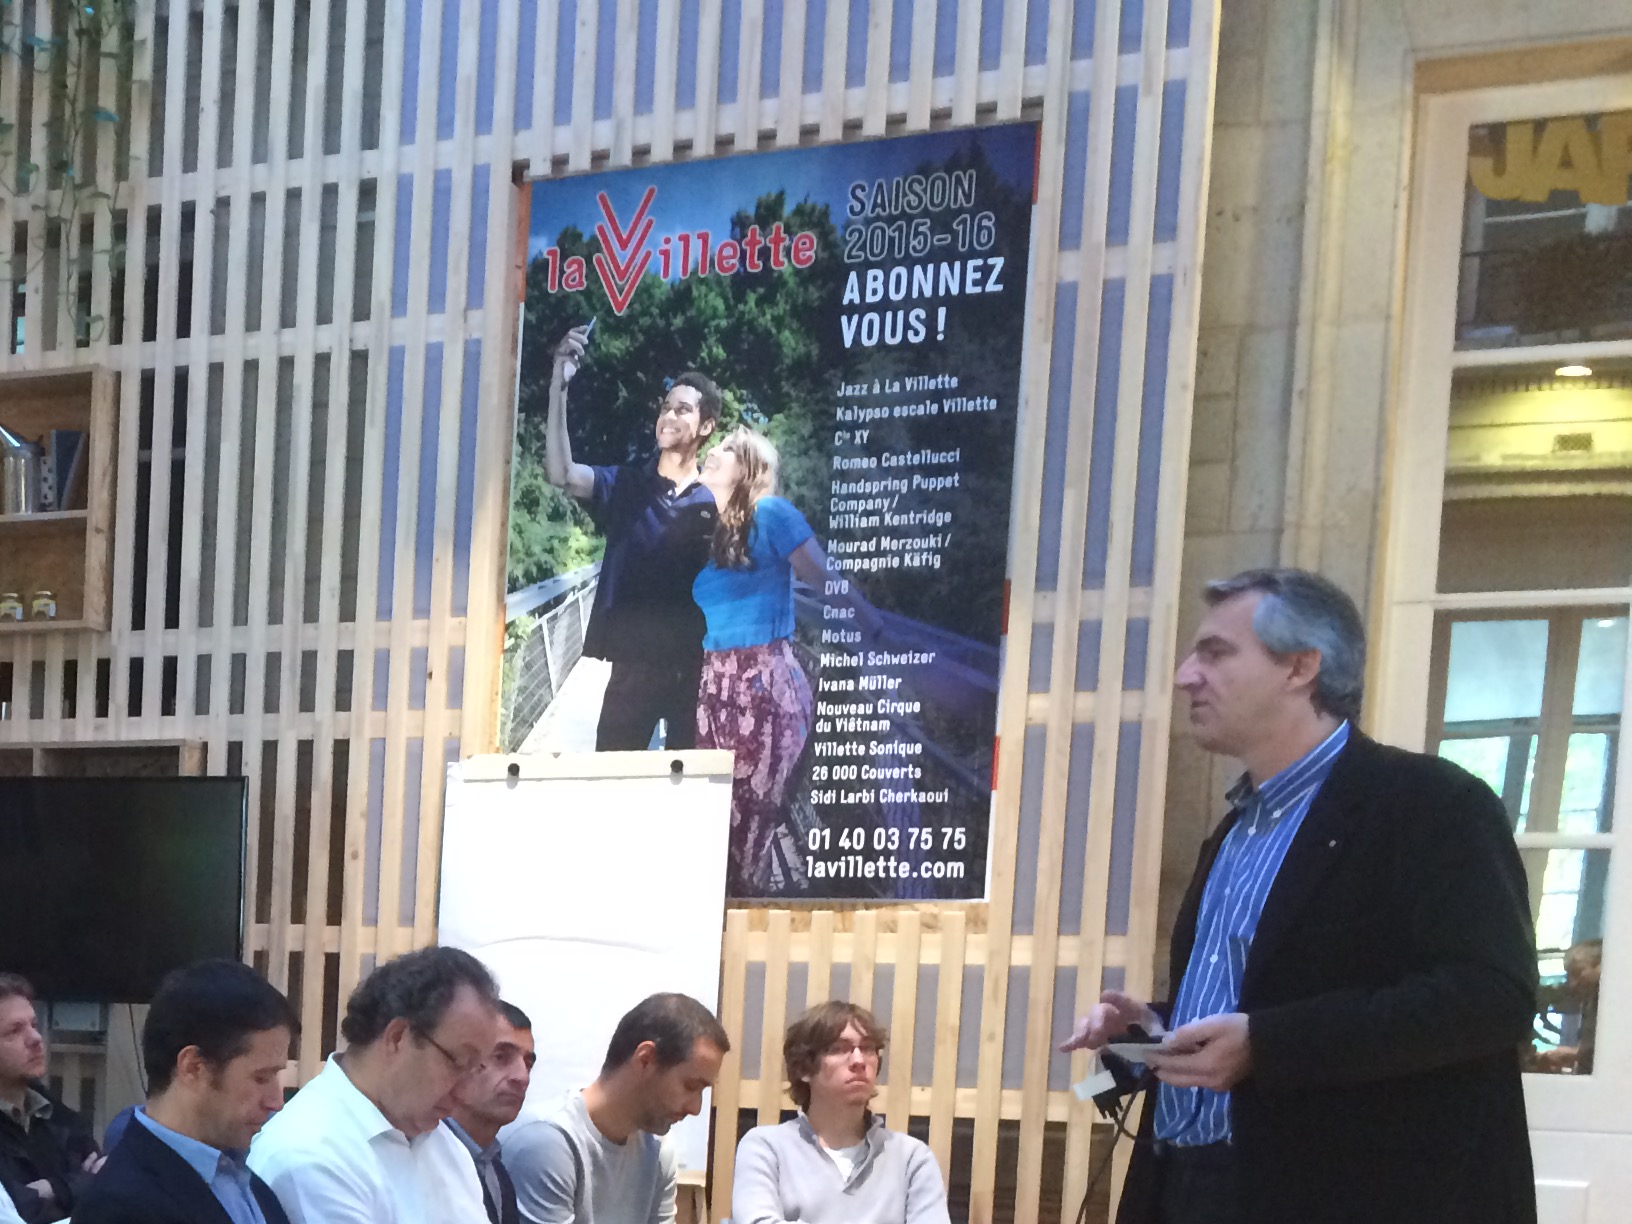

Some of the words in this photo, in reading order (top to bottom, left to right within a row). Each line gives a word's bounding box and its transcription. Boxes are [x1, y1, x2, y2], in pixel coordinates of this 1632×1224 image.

[847, 169, 976, 219] SAISON
[844, 211, 995, 263] 2015-16
[546, 247, 586, 293] la
[594, 185, 816, 316] Villette
[842, 257, 1004, 305] ABONNEZ
[837, 381, 868, 397] Jazz
[873, 379, 880, 394] à
[885, 379, 900, 394] La
[905, 374, 958, 391] Villette
[836, 406, 889, 423] Kalypso
[893, 400, 938, 417] escale
[943, 396, 997, 414] Villette
[854, 430, 869, 444] XY
[833, 456, 877, 470] Romeo
[882, 448, 960, 466] Castellucci
[832, 477, 908, 494] Handspring
[913, 473, 959, 491] Puppet
[829, 513, 879, 529] William
[884, 509, 952, 527] Kentridge
[828, 537, 876, 553] Mourad
[826, 556, 899, 572] Compagnie
[904, 552, 941, 568] Käfig
[823, 606, 855, 619] Cnac
[822, 630, 861, 643] Motus
[820, 652, 863, 668] Michel
[868, 651, 935, 666] Schweizer
[819, 678, 854, 692] Ivana
[859, 675, 902, 691] Müller
[817, 701, 873, 716] Nouveau
[877, 699, 920, 716] Cirque
[816, 718, 831, 733] du
[835, 718, 890, 733] Viêtnam
[814, 742, 865, 757] Villette
[869, 740, 922, 757] Sonique
[812, 766, 828, 780] 26
[832, 766, 857, 779] 000
[861, 764, 921, 779] Couverts
[811, 789, 836, 804] Sidi
[841, 788, 874, 804] Larbi
[879, 788, 949, 803] Cherkaoui
[808, 828, 830, 850] 01
[839, 827, 865, 850] 40
[873, 828, 899, 850] 03
[908, 827, 932, 850] 75
[941, 827, 966, 849] 75
[806, 856, 964, 878] lavillette.com
